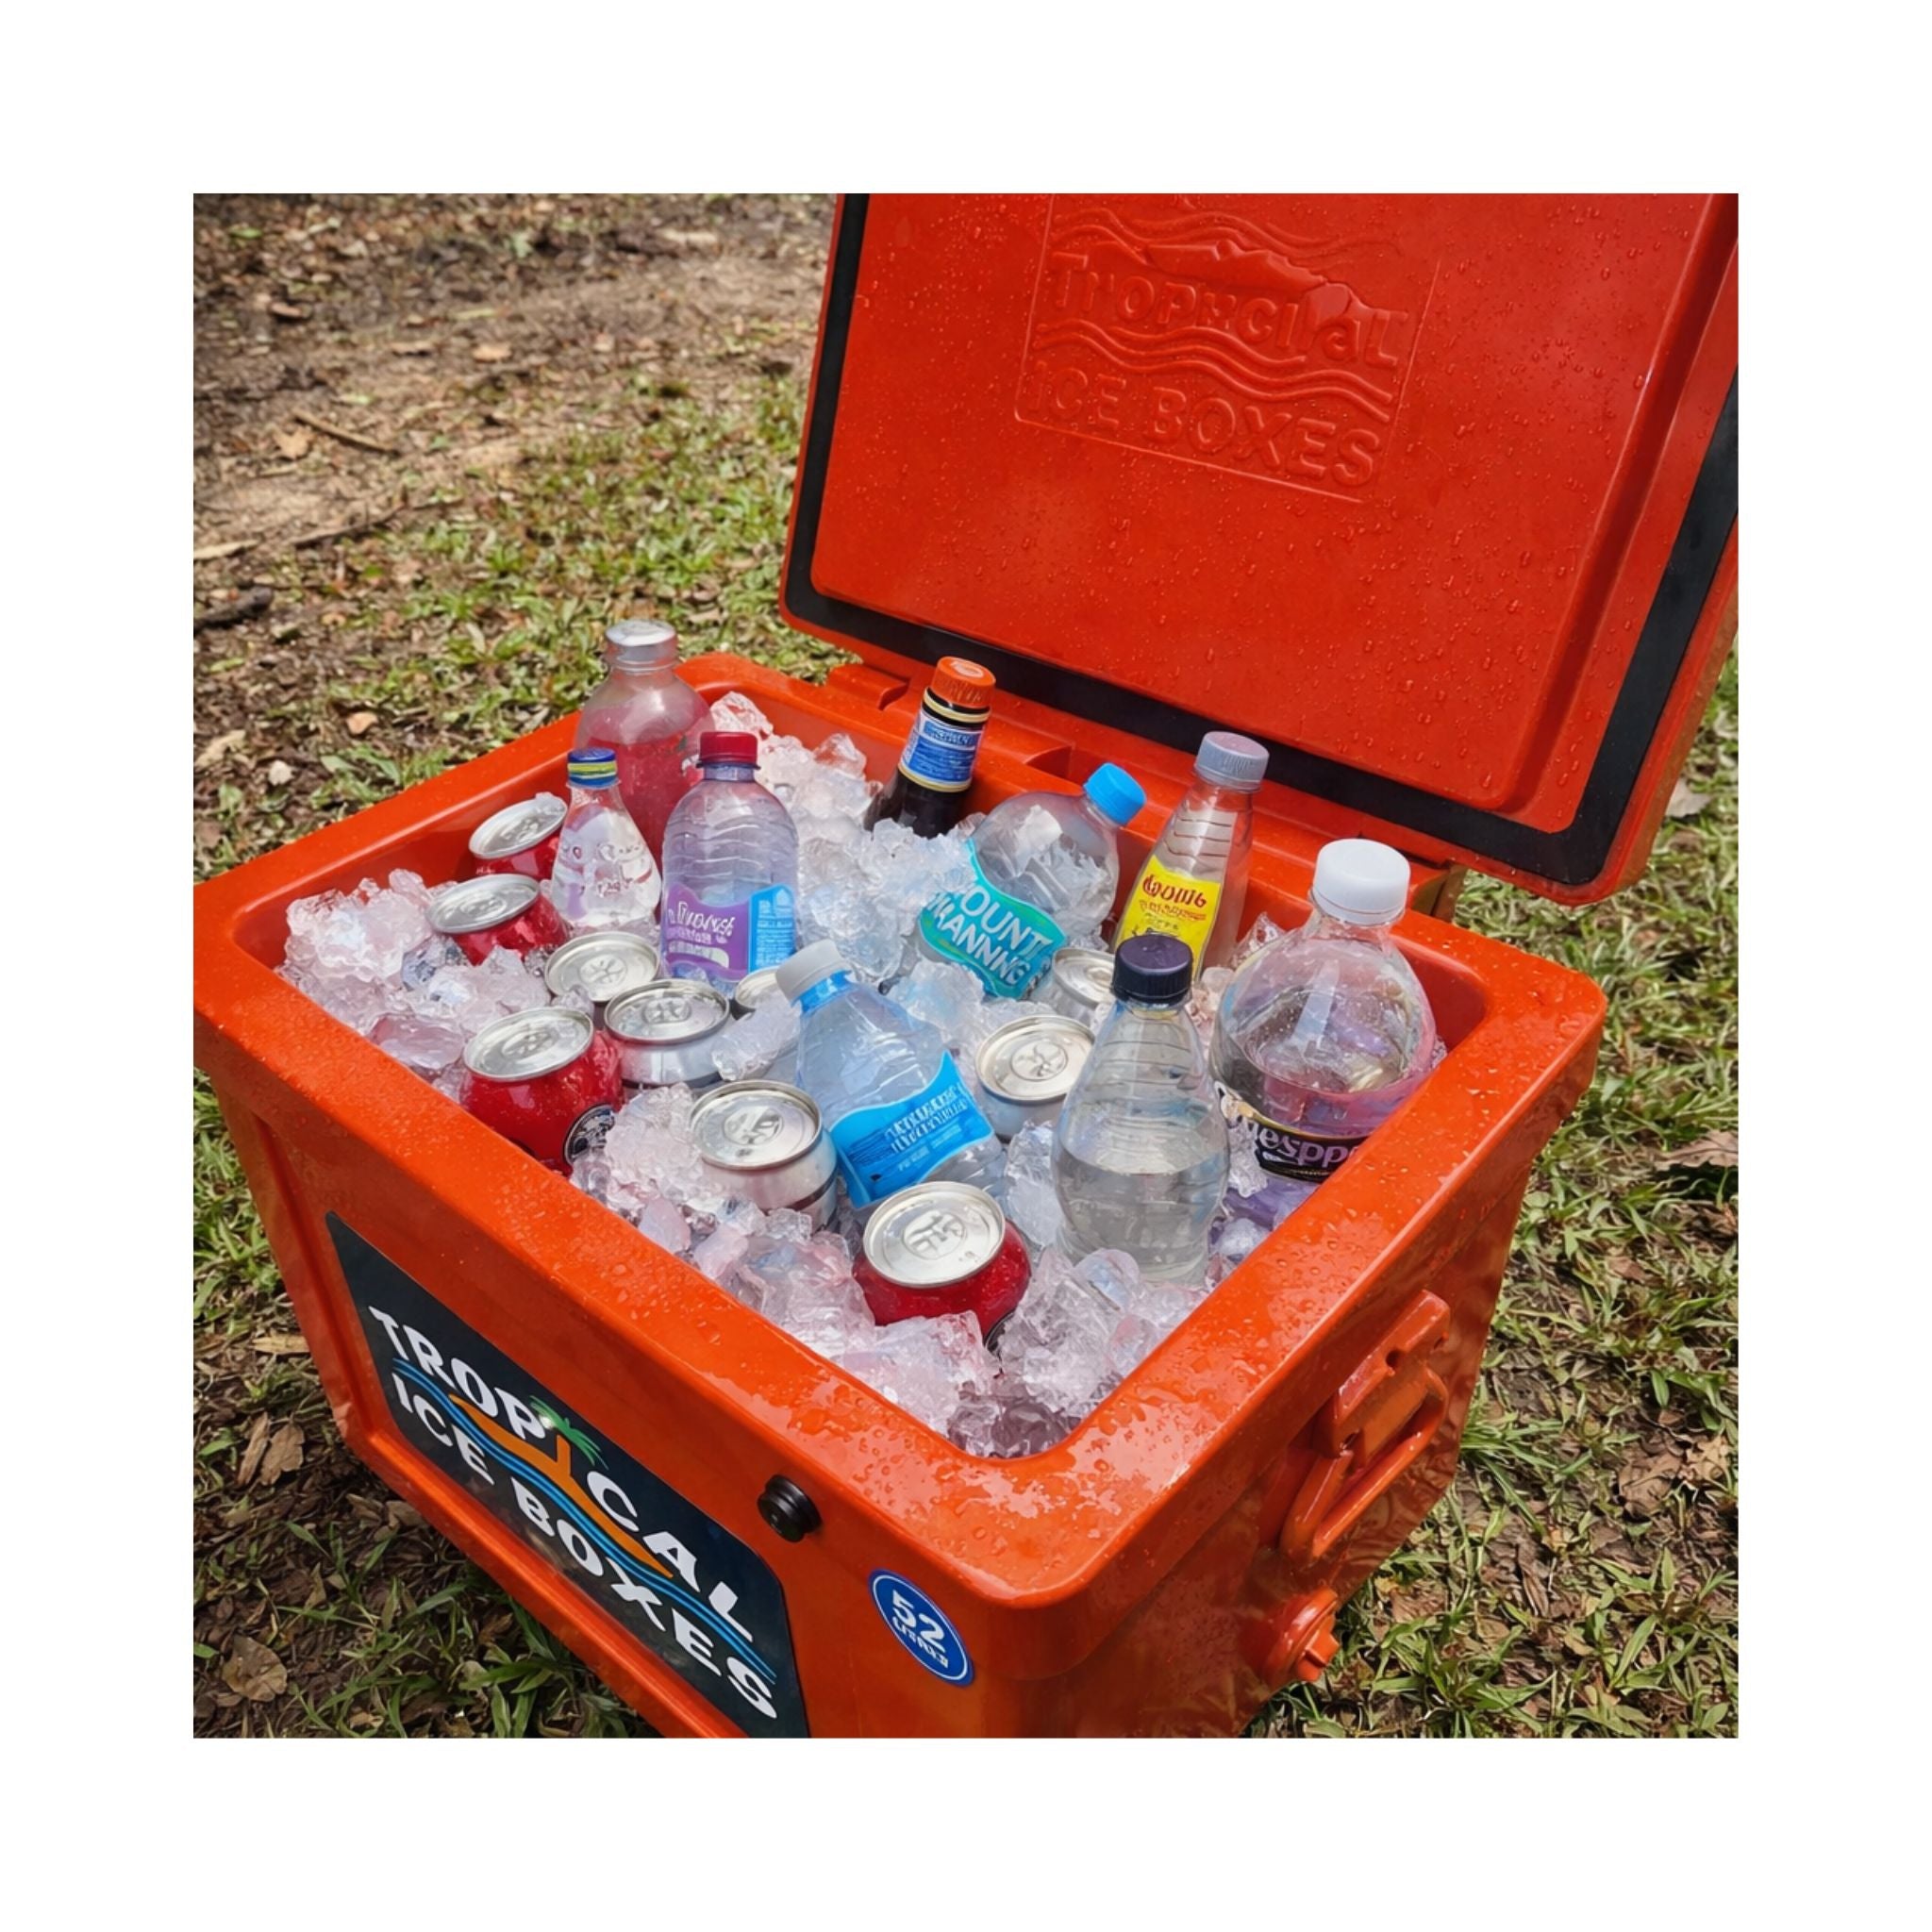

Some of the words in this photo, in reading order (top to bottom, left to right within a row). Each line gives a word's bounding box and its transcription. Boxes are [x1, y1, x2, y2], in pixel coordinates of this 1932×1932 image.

[1143, 384, 1381, 487] BOXES
[391, 1373, 495, 1485] ICE
[510, 1476, 778, 1719] BOXES
[892, 1589, 946, 1654] 52
